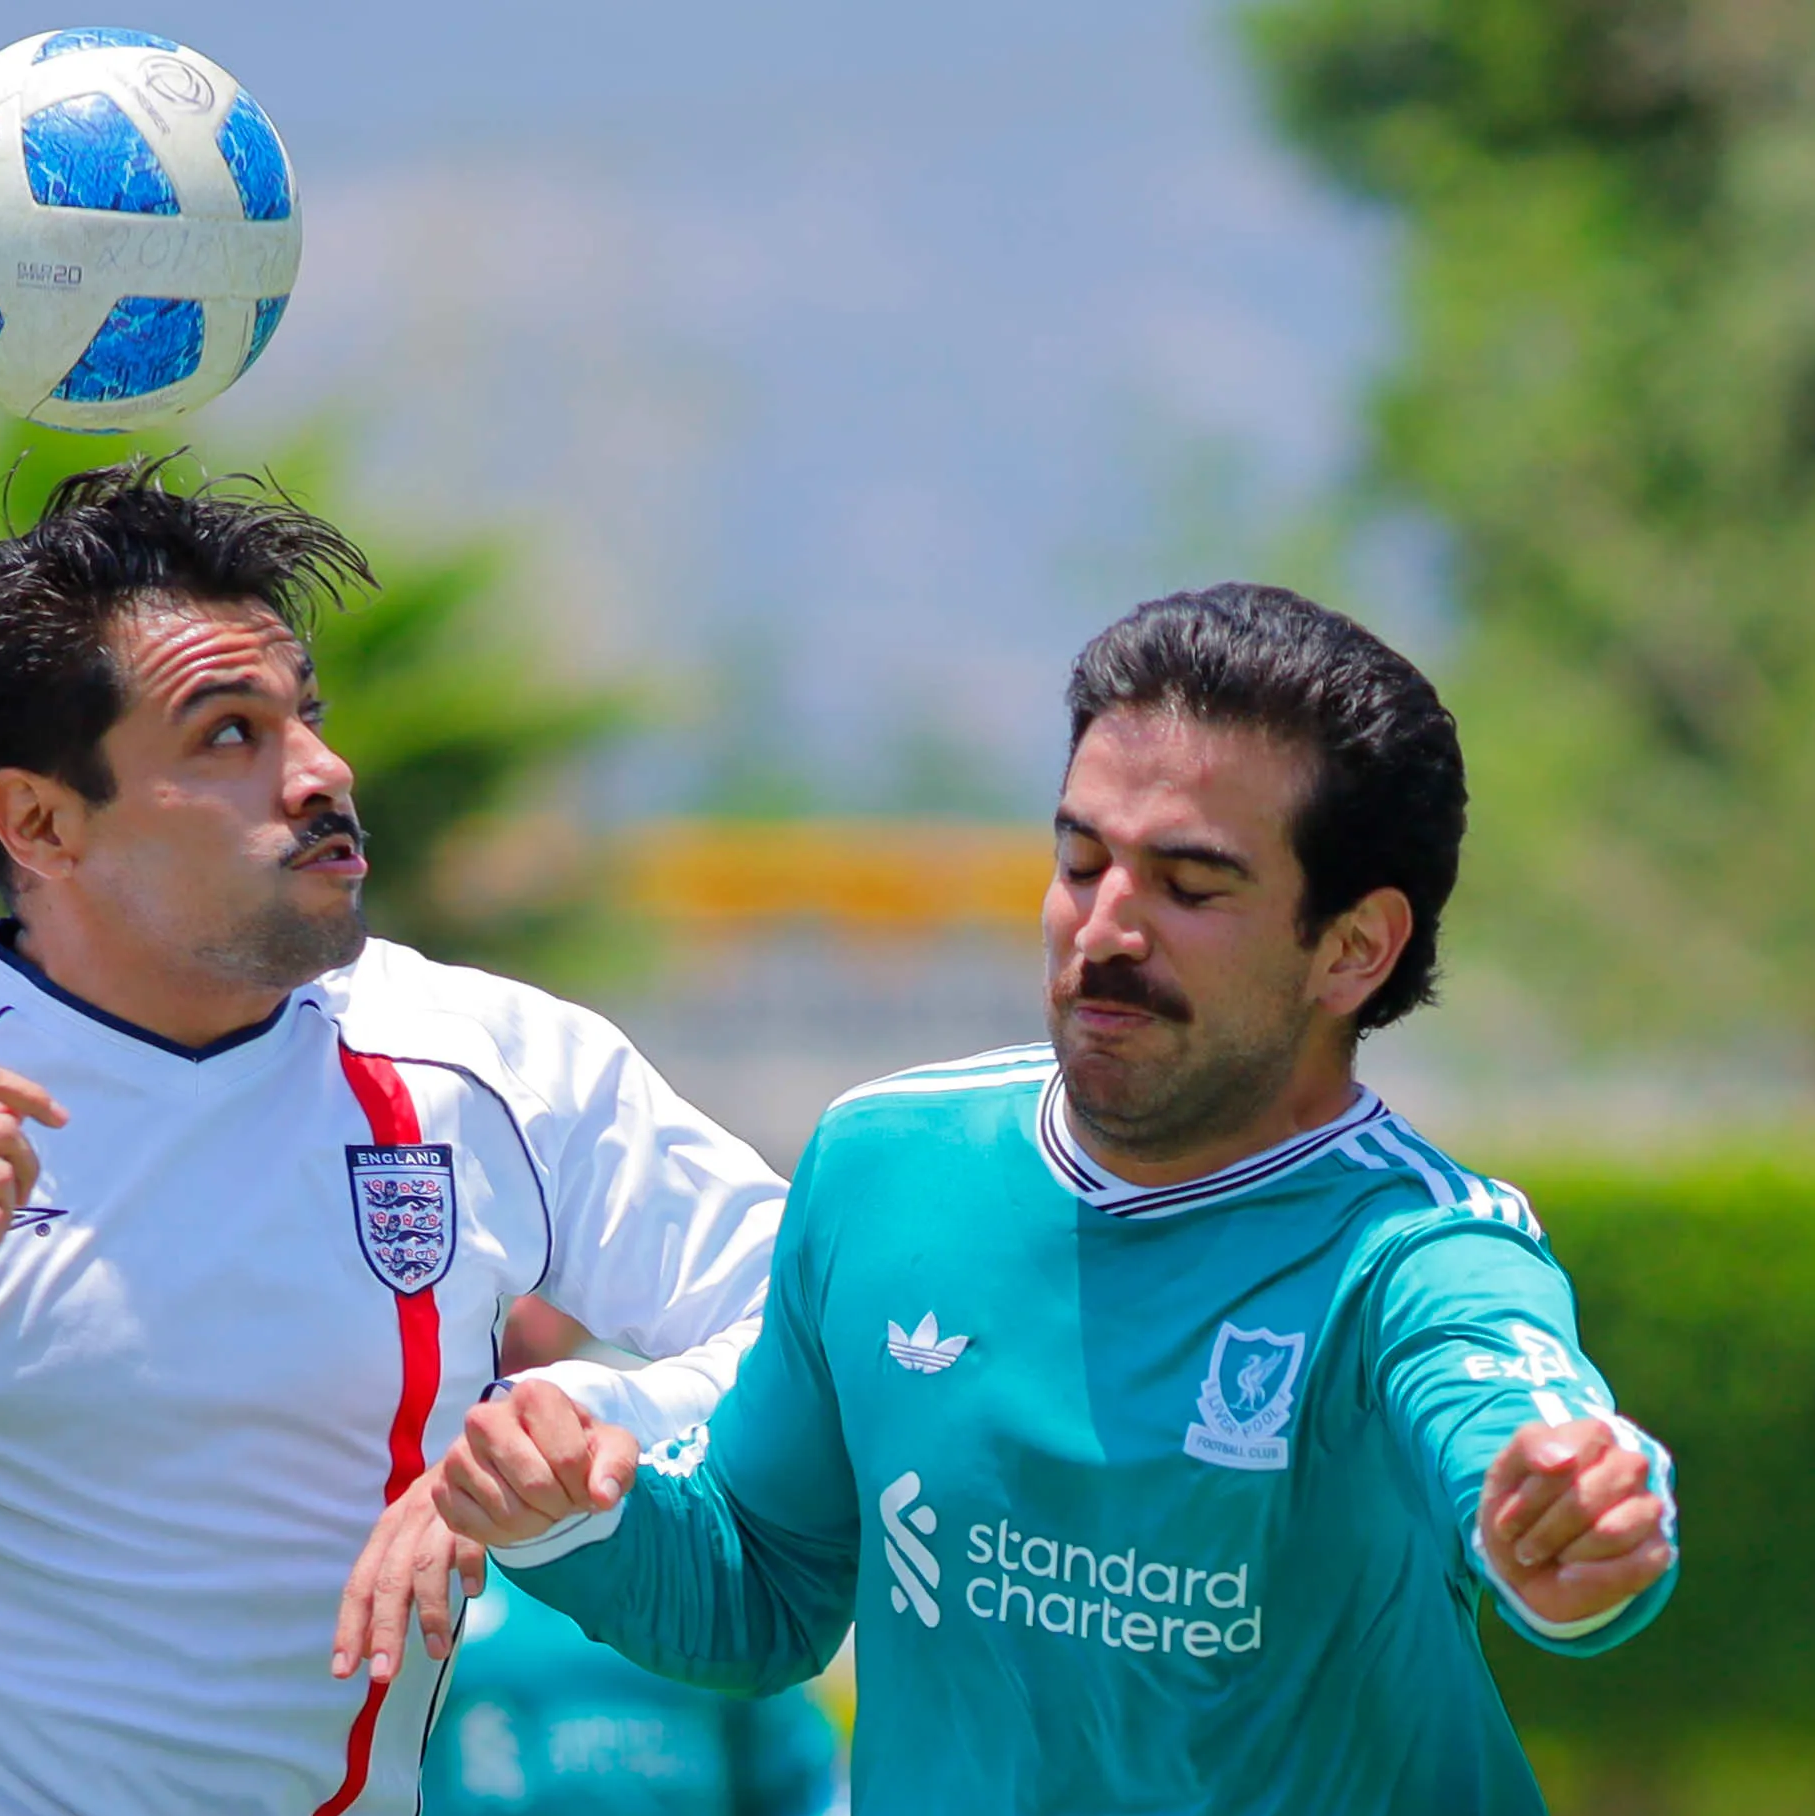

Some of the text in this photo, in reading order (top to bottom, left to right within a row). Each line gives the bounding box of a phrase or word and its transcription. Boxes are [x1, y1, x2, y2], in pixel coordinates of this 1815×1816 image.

[357, 1152, 441, 1165] ENGLAND
[1197, 1436, 1279, 1459] FOOTBALL CLUB
[966, 1518, 1248, 1609] standard
[965, 1573, 1262, 1658] chartered
